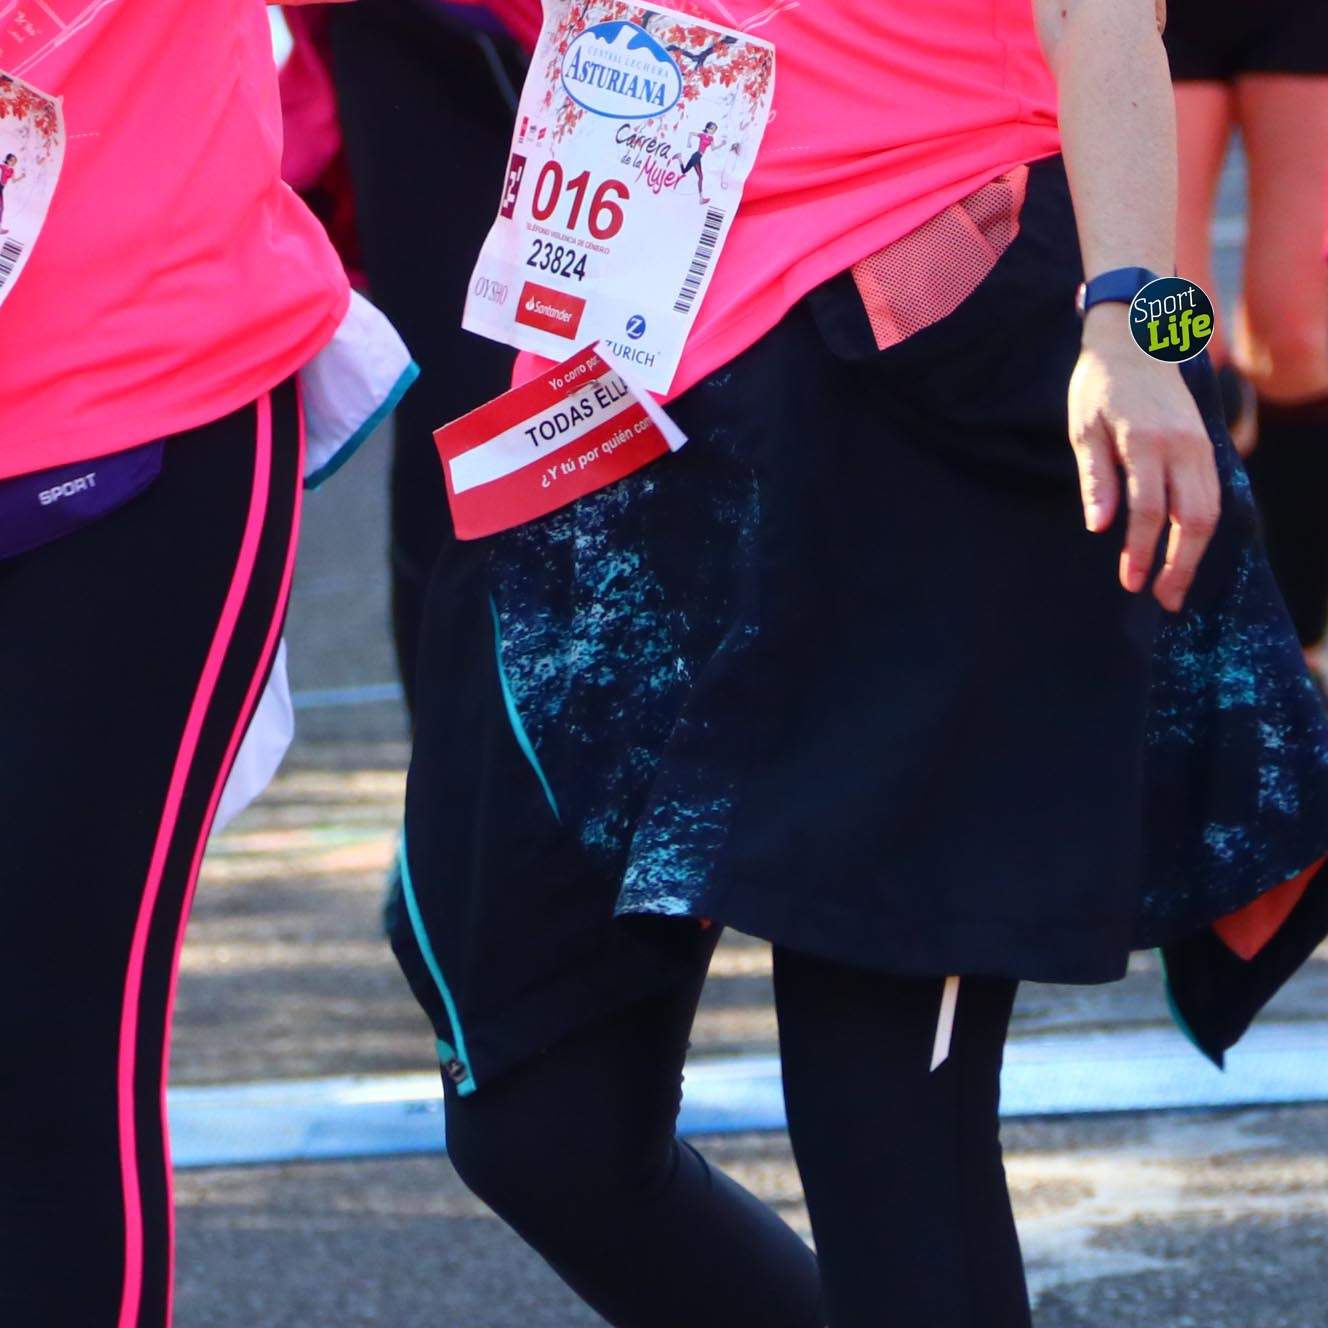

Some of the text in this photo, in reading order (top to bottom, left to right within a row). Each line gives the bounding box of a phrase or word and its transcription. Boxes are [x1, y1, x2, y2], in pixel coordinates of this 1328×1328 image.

[564, 45, 667, 107] ASTURIANA
[615, 123, 672, 160] Carrera
[620, 149, 686, 194] de la Mujer
[531, 160, 631, 241] 016
[526, 238, 588, 282] 23824
[475, 276, 509, 306] OYSHO
[534, 300, 573, 323] Santander
[548, 378, 564, 391] Yo
[564, 363, 587, 383] corro
[524, 397, 594, 447] TODAS
[541, 465, 558, 488] ¿Y
[560, 458, 576, 475] tú
[577, 447, 601, 470] por
[601, 428, 634, 455] quién
[37, 472, 97, 506] SPORT
